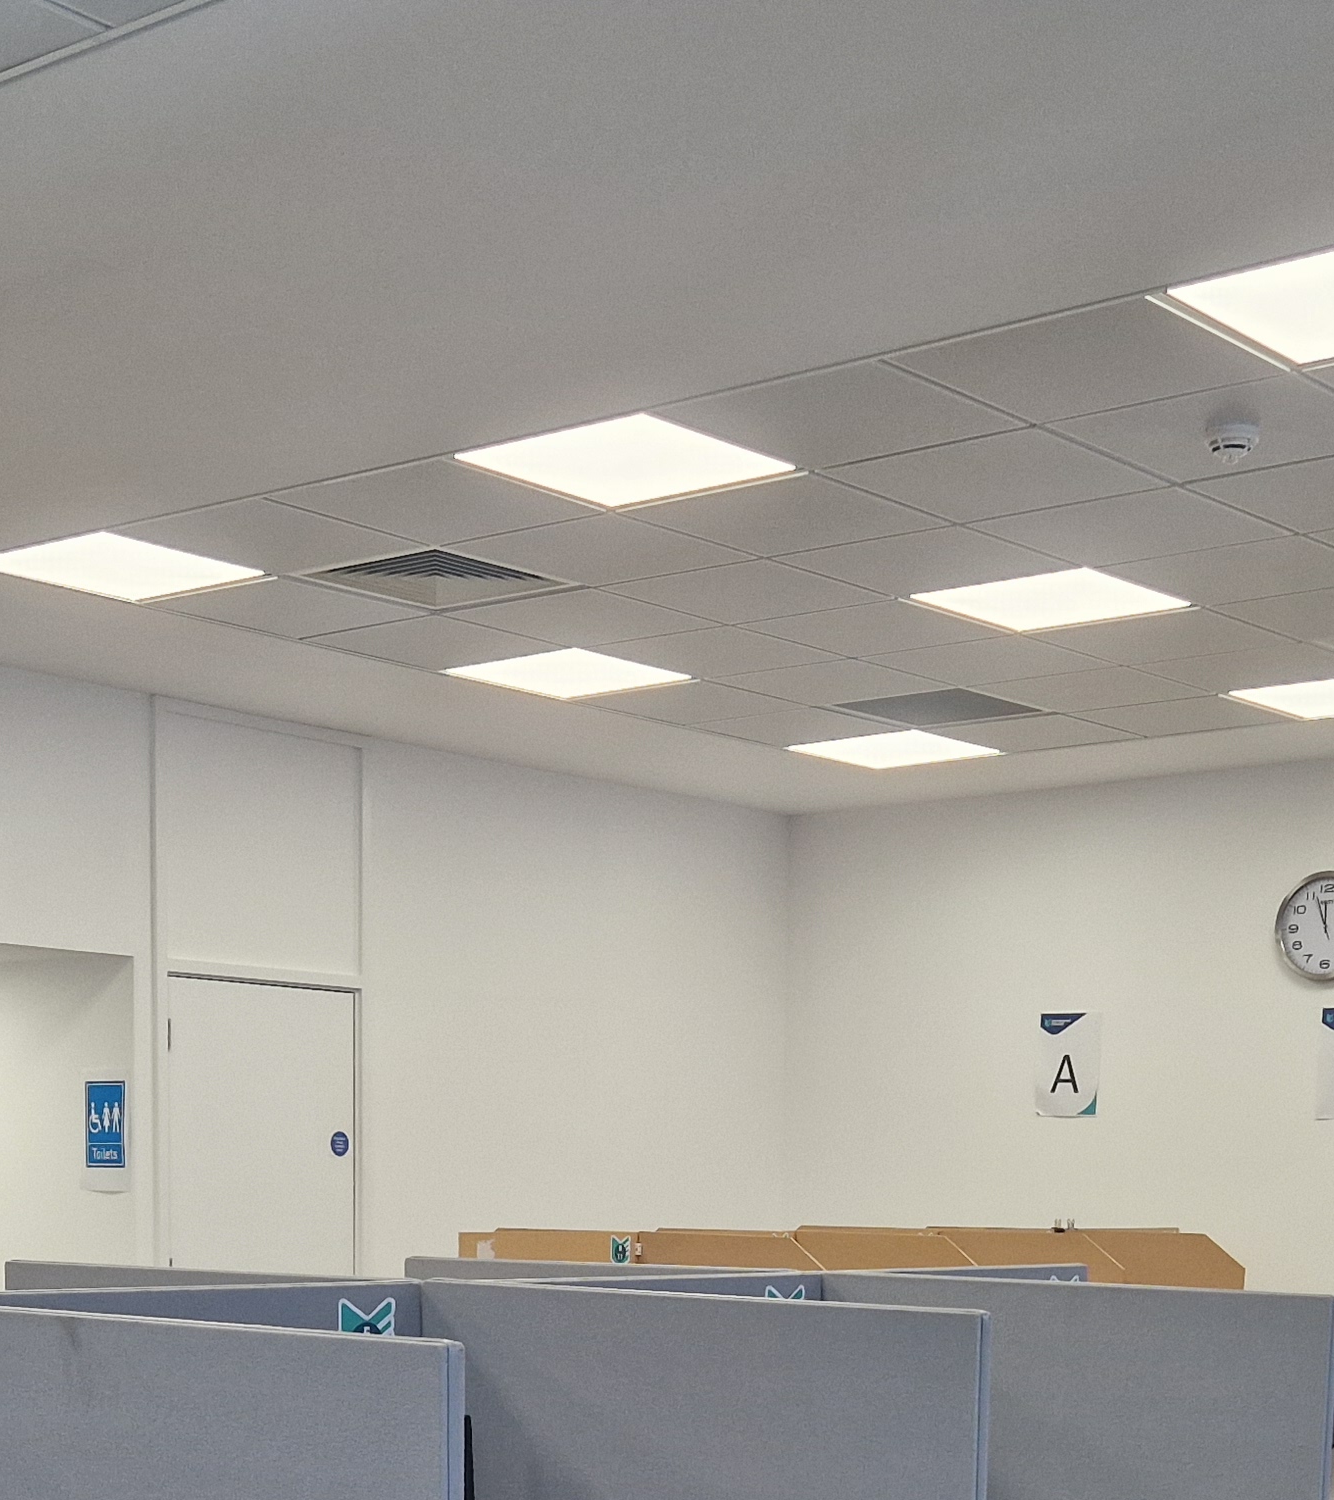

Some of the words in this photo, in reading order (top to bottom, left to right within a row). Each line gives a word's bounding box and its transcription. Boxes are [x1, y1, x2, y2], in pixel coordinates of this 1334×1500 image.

[1320, 883, 1334, 893] 12
[1307, 891, 1316, 900] 11
[1293, 905, 1307, 915] 10
[1288, 924, 1299, 934] 9
[1292, 941, 1303, 950] 8
[1303, 953, 1313, 963] 7
[1319, 960, 1331, 969] 6
[1050, 1054, 1079, 1094] A
[91, 1147, 118, 1160] Toilets
